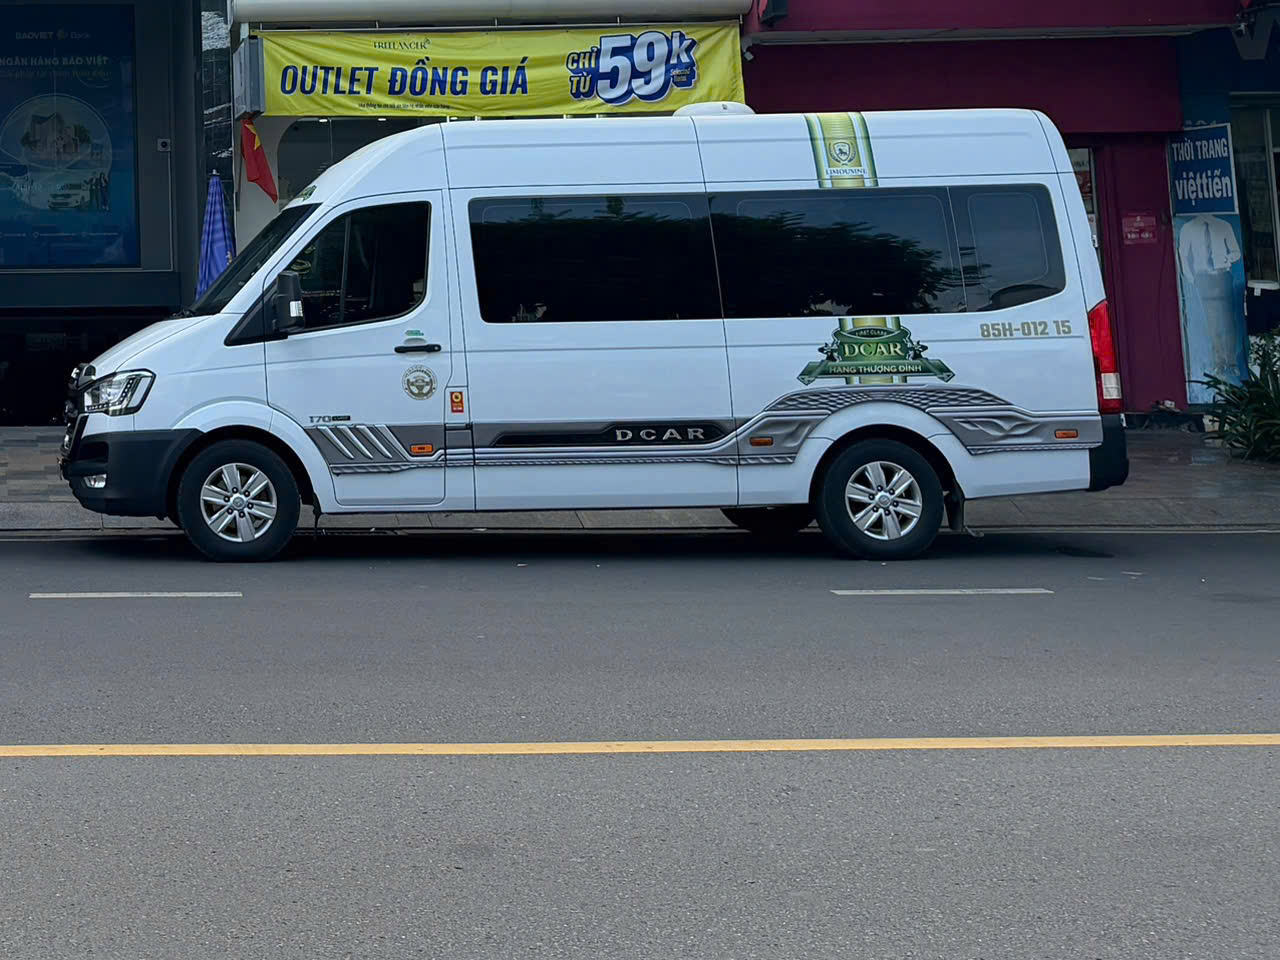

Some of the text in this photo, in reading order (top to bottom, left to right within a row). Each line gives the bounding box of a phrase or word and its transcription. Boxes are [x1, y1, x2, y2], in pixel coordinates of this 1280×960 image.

[373, 39, 428, 50] FREELANCER
[566, 46, 599, 70] CHỈ
[279, 56, 529, 96] OUTLET ĐỒNG GIÁ
[569, 72, 592, 94] TỪ
[1171, 136, 1229, 162] THỜI TRANG
[843, 342, 905, 357] DCAR
[858, 365, 898, 374] THƯỢNG
[615, 427, 705, 441] DCAR
